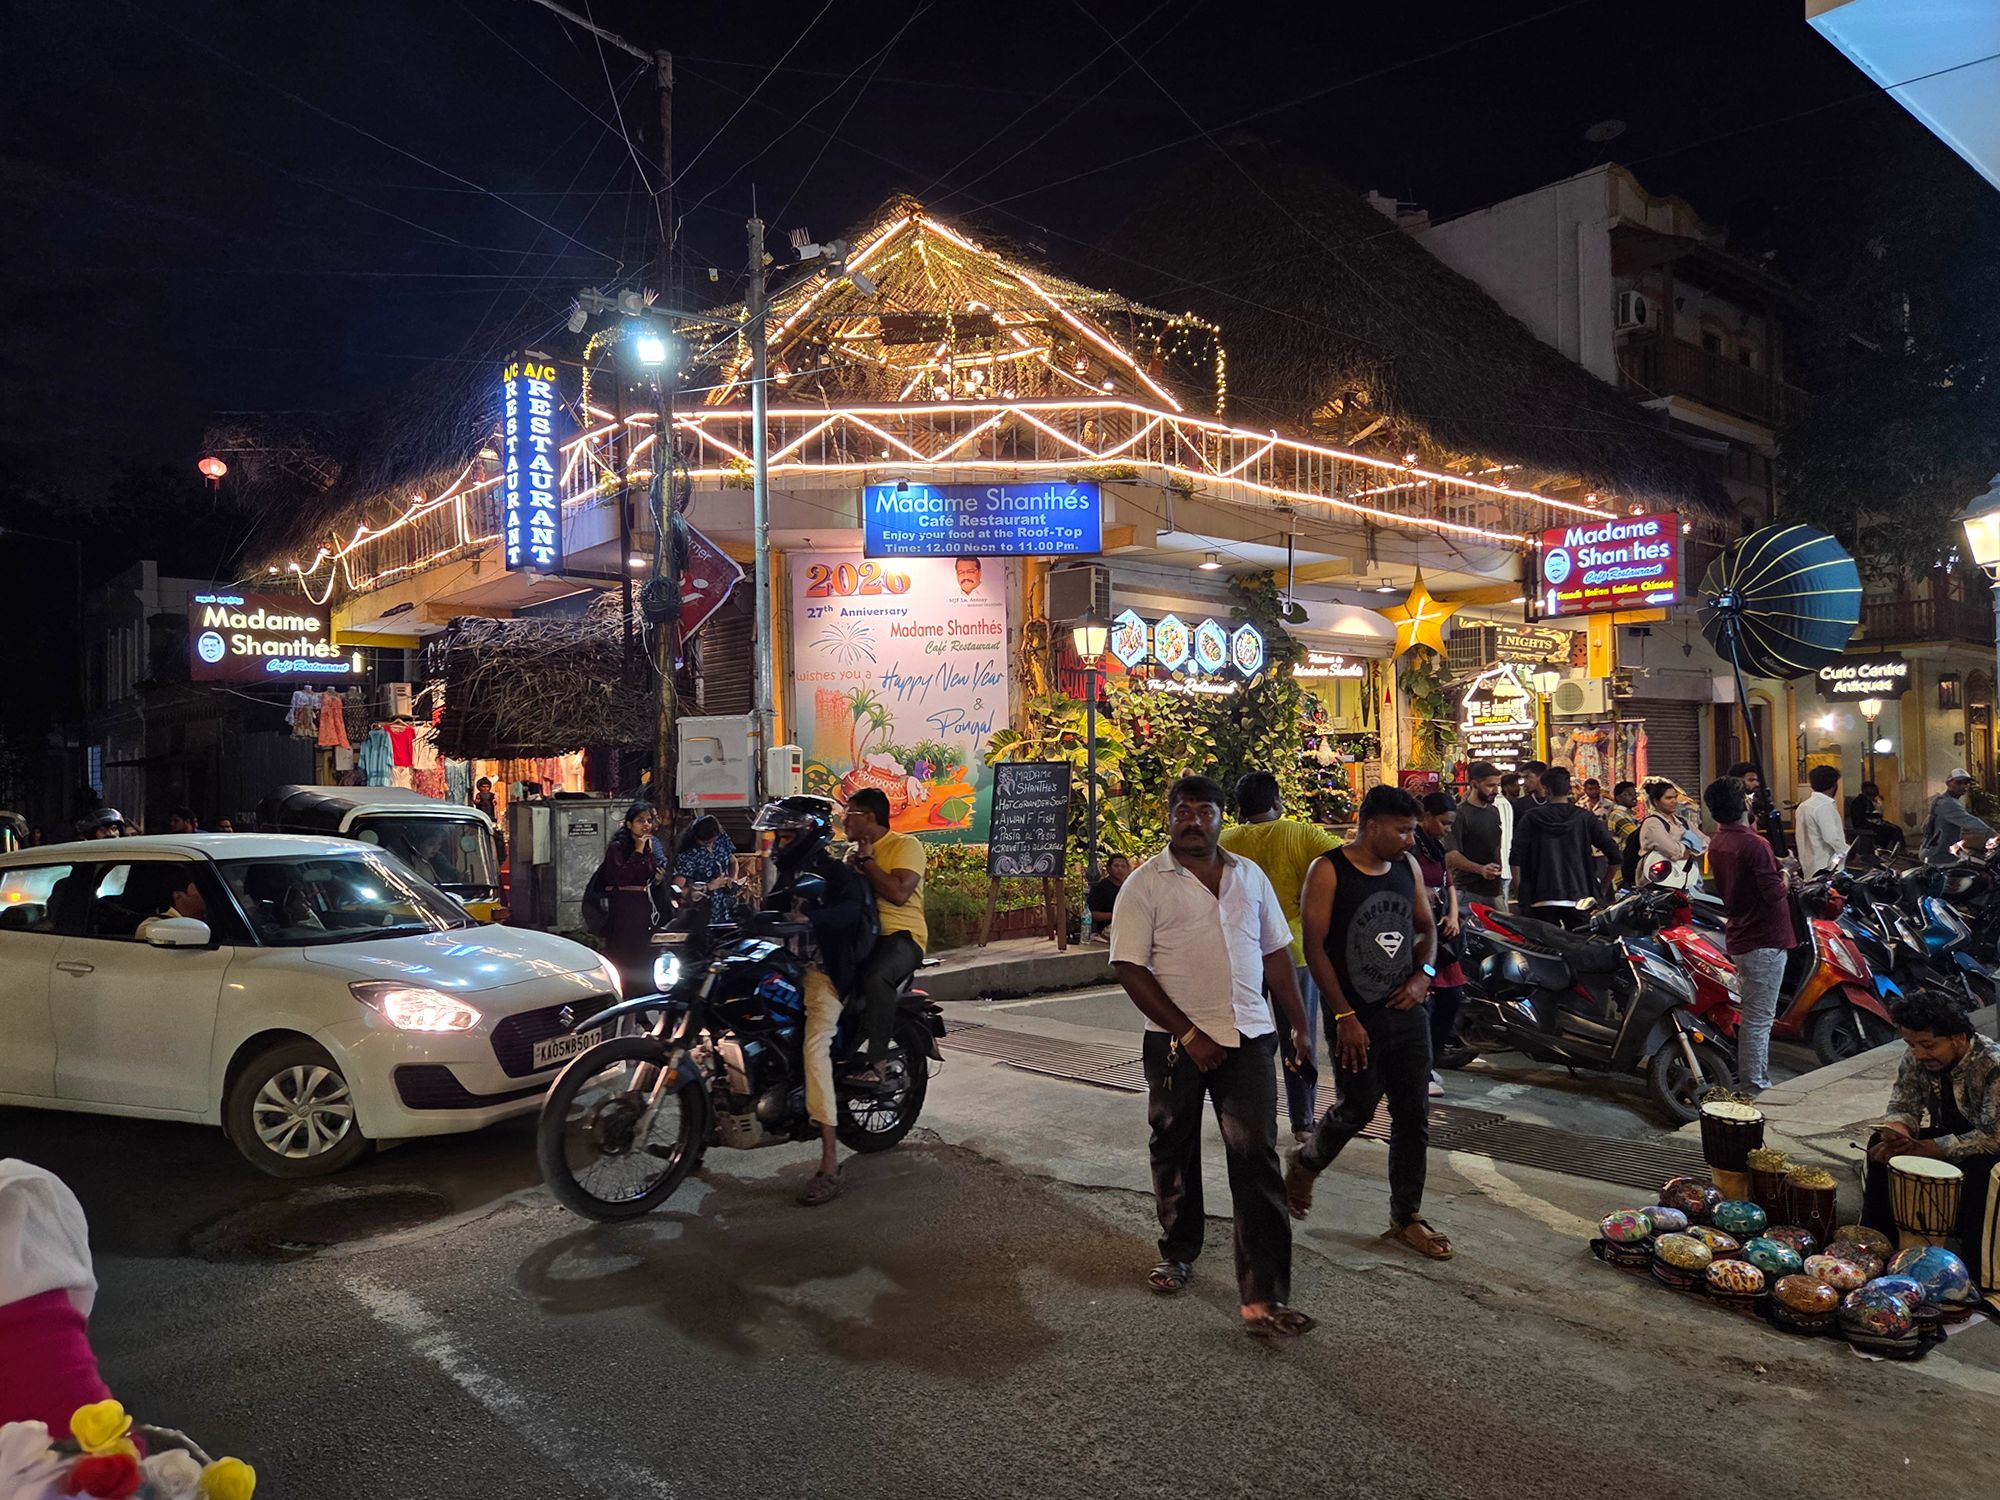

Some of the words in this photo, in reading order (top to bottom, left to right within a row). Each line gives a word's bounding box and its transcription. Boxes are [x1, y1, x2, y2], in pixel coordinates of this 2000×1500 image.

[504, 362, 519, 382] A/C
[524, 362, 556, 381] A/C
[505, 381, 520, 565] RESTAURANT
[527, 378, 556, 564] RESTAURANT
[876, 489, 978, 513] Madame
[986, 487, 1090, 512] Shanthés
[918, 512, 954, 527] Café
[960, 513, 1046, 526] Restaurant
[883, 531, 915, 541] Enjoy
[919, 531, 945, 541] your
[948, 530, 975, 539] food
[978, 530, 991, 538] at
[994, 529, 1014, 538] the
[1018, 527, 1082, 539] Roof-Top
[1564, 522, 1660, 548] Madame
[885, 544, 921, 553] Time:
[926, 543, 960, 552] 12.00
[964, 543, 996, 552] Noon
[1001, 543, 1013, 551] to
[1018, 542, 1053, 551] 11.00
[1056, 541, 1079, 550] Pm.
[806, 561, 911, 597] 2026
[1583, 569, 1606, 584] Café
[1606, 564, 1663, 581] Restaurant
[1557, 589, 1582, 600] French
[1612, 584, 1637, 594] Indian
[1641, 580, 1674, 591] Chinese
[203, 606, 320, 632] Madame
[807, 605, 833, 619] 27th
[840, 607, 908, 618] Anniversary
[890, 620, 944, 638] Madame
[947, 618, 1003, 636] Shanthés
[231, 634, 341, 658] Shanthés
[925, 641, 947, 655] Café
[950, 640, 1001, 652] Restaurant
[1505, 636, 1553, 649] NIGHTS
[266, 659, 293, 674] Café
[293, 660, 350, 673] Restaurant
[1819, 665, 1857, 680] Curio
[1858, 662, 1908, 678] Centre
[796, 670, 835, 681] wishes
[840, 669, 861, 681] you
[865, 671, 872, 679] a
[878, 661, 933, 704] Happy
[935, 661, 970, 692] New
[970, 659, 1004, 693] Year
[1833, 680, 1893, 692] Antiques
[973, 697, 984, 710] &
[926, 708, 995, 750] Pongal
